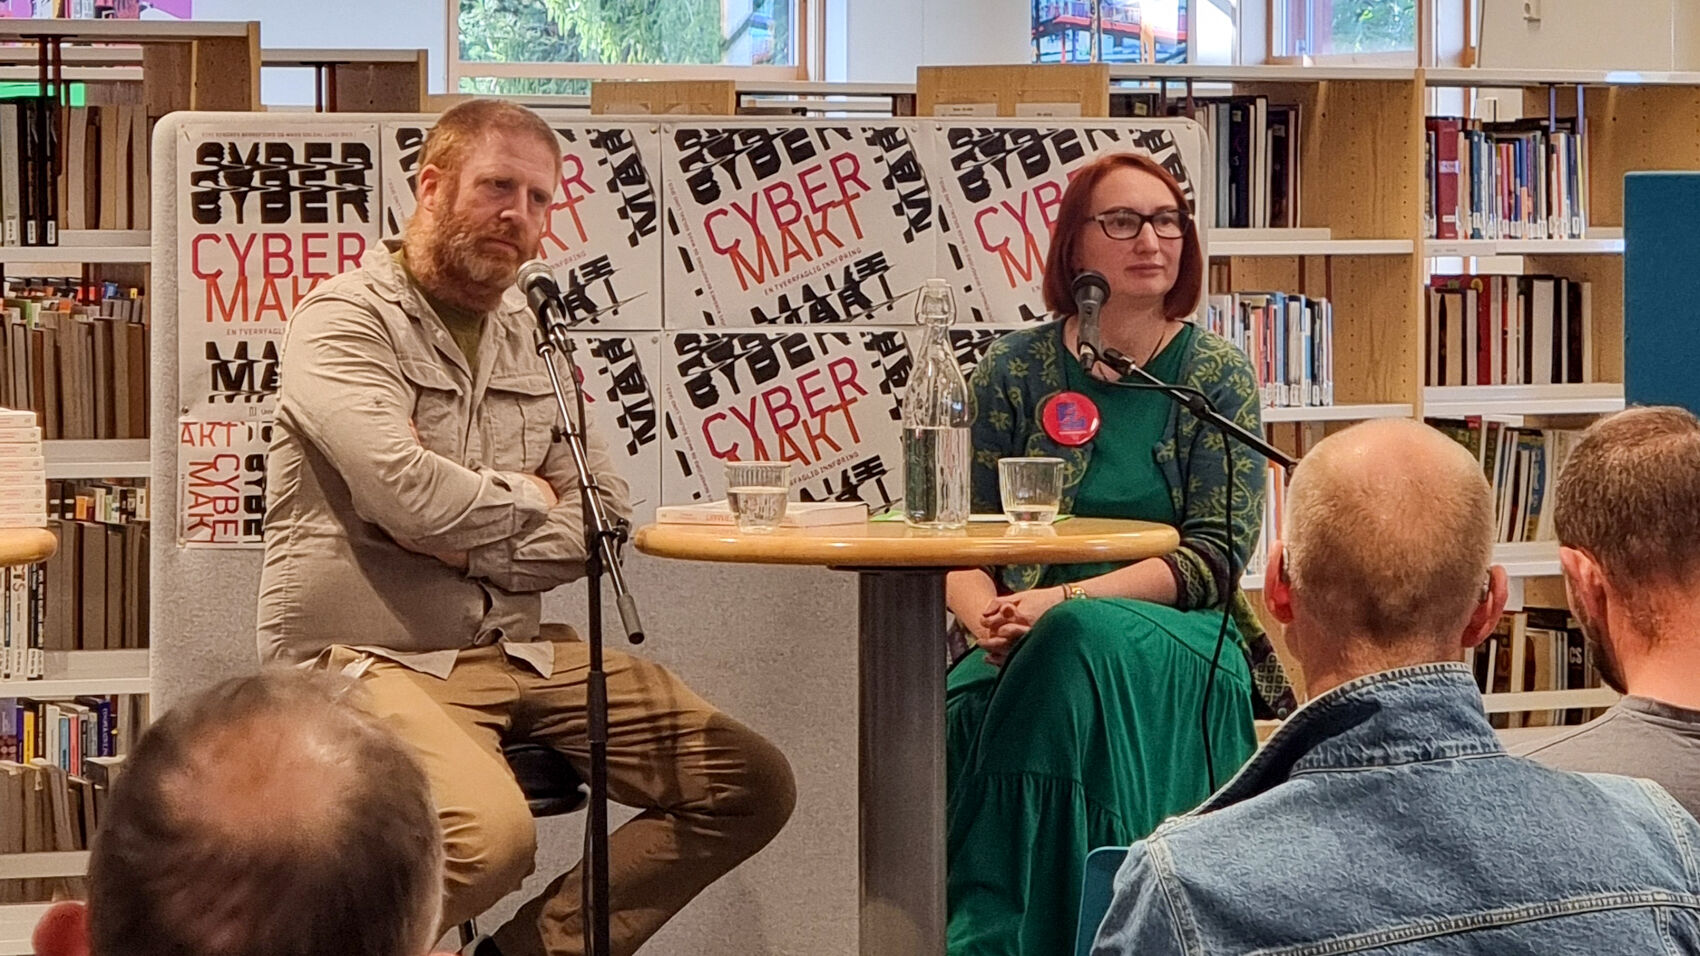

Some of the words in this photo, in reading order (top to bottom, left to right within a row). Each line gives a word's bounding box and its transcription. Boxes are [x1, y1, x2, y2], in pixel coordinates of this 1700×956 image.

[703, 152, 872, 255] CYBER
[728, 192, 864, 291] MAKT
[192, 232, 366, 280] CYBER
[206, 275, 335, 322] MAK
[701, 356, 869, 459] CYBER
